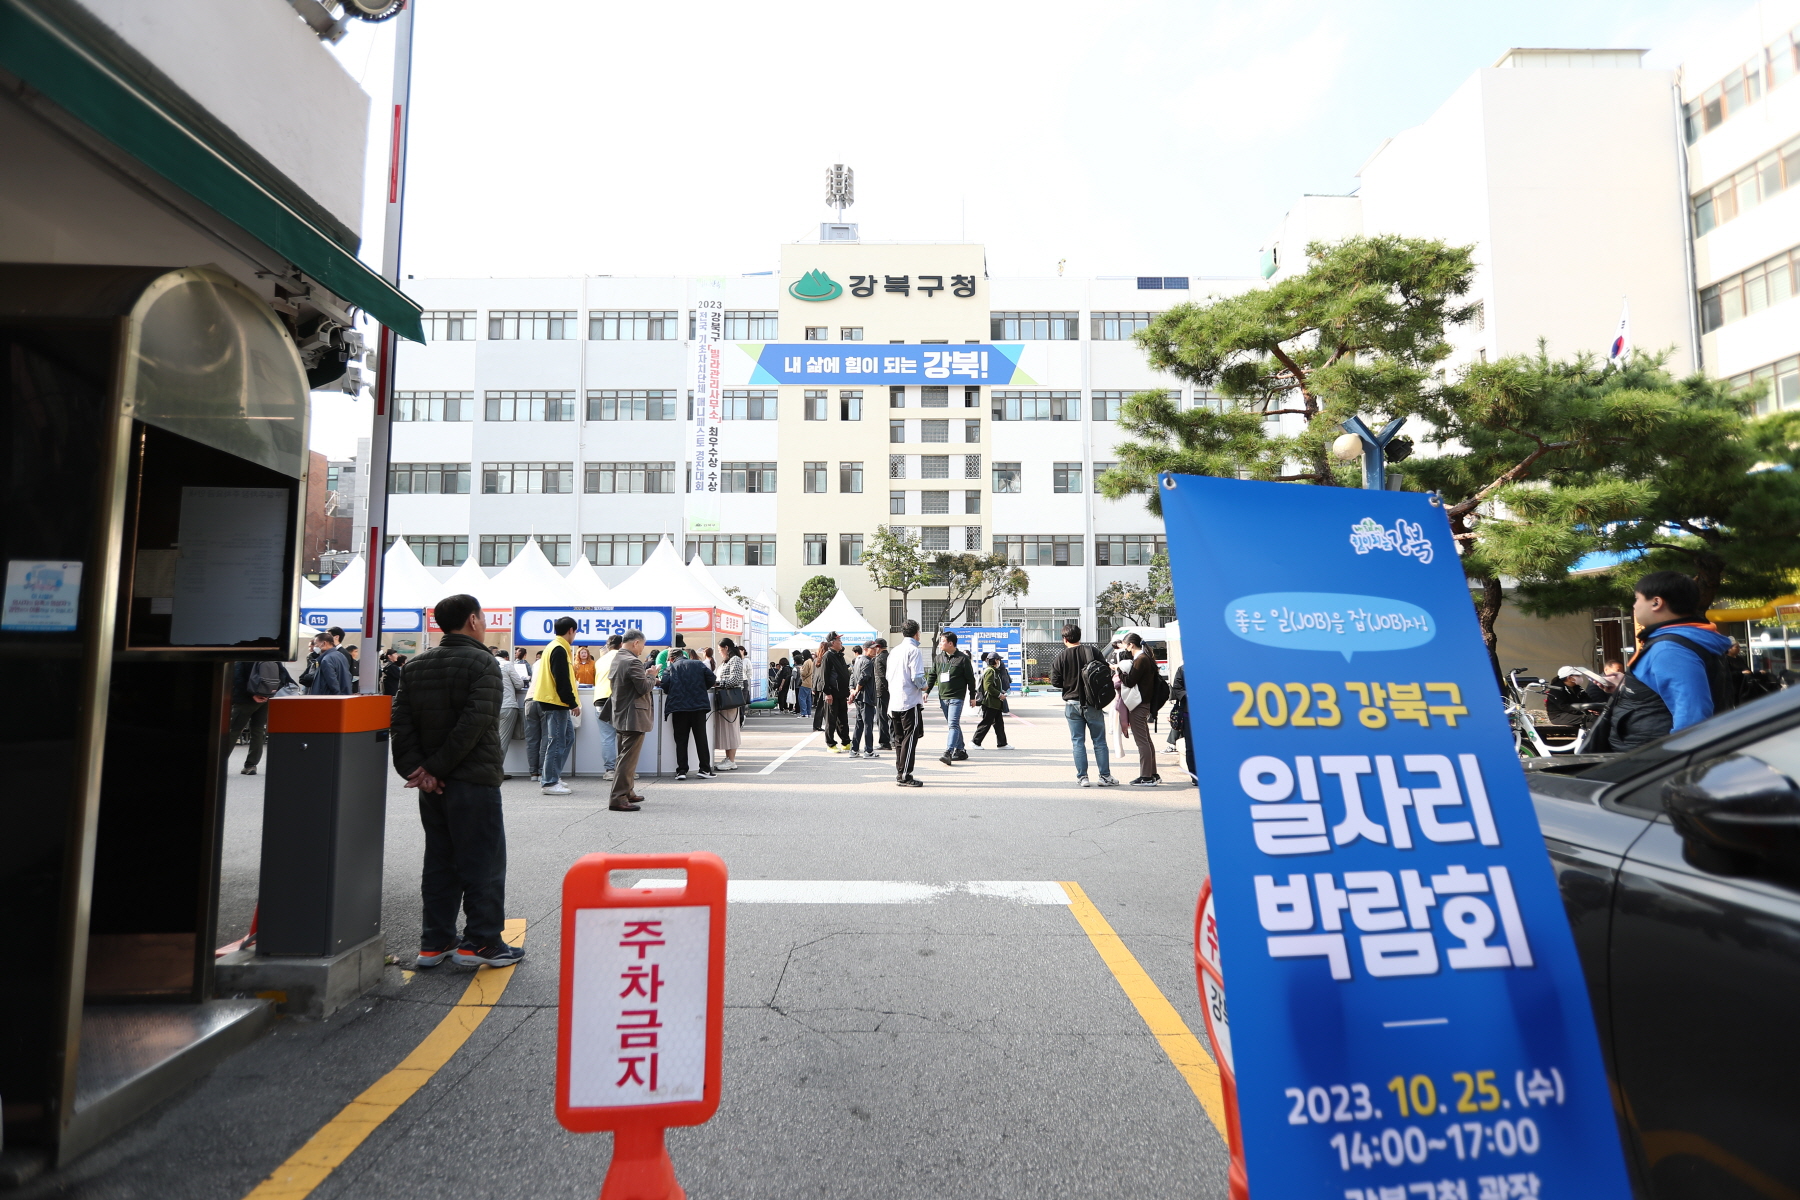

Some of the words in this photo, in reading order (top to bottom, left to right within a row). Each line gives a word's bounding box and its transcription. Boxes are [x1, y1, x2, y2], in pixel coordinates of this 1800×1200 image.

[698, 300, 722, 310] 2023
[849, 274, 976, 298] 강북구청
[710, 312, 721, 342] 강북구
[696, 334, 708, 394] 기초자치단체
[784, 356, 801, 374] 내
[806, 356, 840, 374] 삶에
[845, 356, 878, 374] 힘이
[883, 356, 917, 374] 되는
[923, 350, 989, 380] 강북!
[708, 426, 719, 468] 최우수상
[694, 450, 705, 492] 경진대회
[707, 471, 718, 493] 수상
[1385, 518, 1434, 564] 강북
[311, 616, 326, 625] A15
[543, 619, 589, 634] 이서
[595, 619, 643, 636] 작성대
[1235, 609, 1267, 633] 좋은
[1270, 606, 1345, 634] 일(JOB)을
[1347, 607, 1430, 633] 잡(JOB)자!
[1227, 681, 1342, 728] 2023
[1344, 681, 1468, 730] 강북구
[1238, 752, 1500, 856] 일자리
[1253, 864, 1535, 981] 박람회
[616, 920, 666, 1092] 주차금지
[1285, 1083, 1383, 1125] 2023.
[1387, 1074, 1448, 1118] 10.
[1453, 1070, 1511, 1112] 25.
[1515, 1067, 1566, 1108] (수)
[1330, 1117, 1541, 1171] 14:00~17:00
